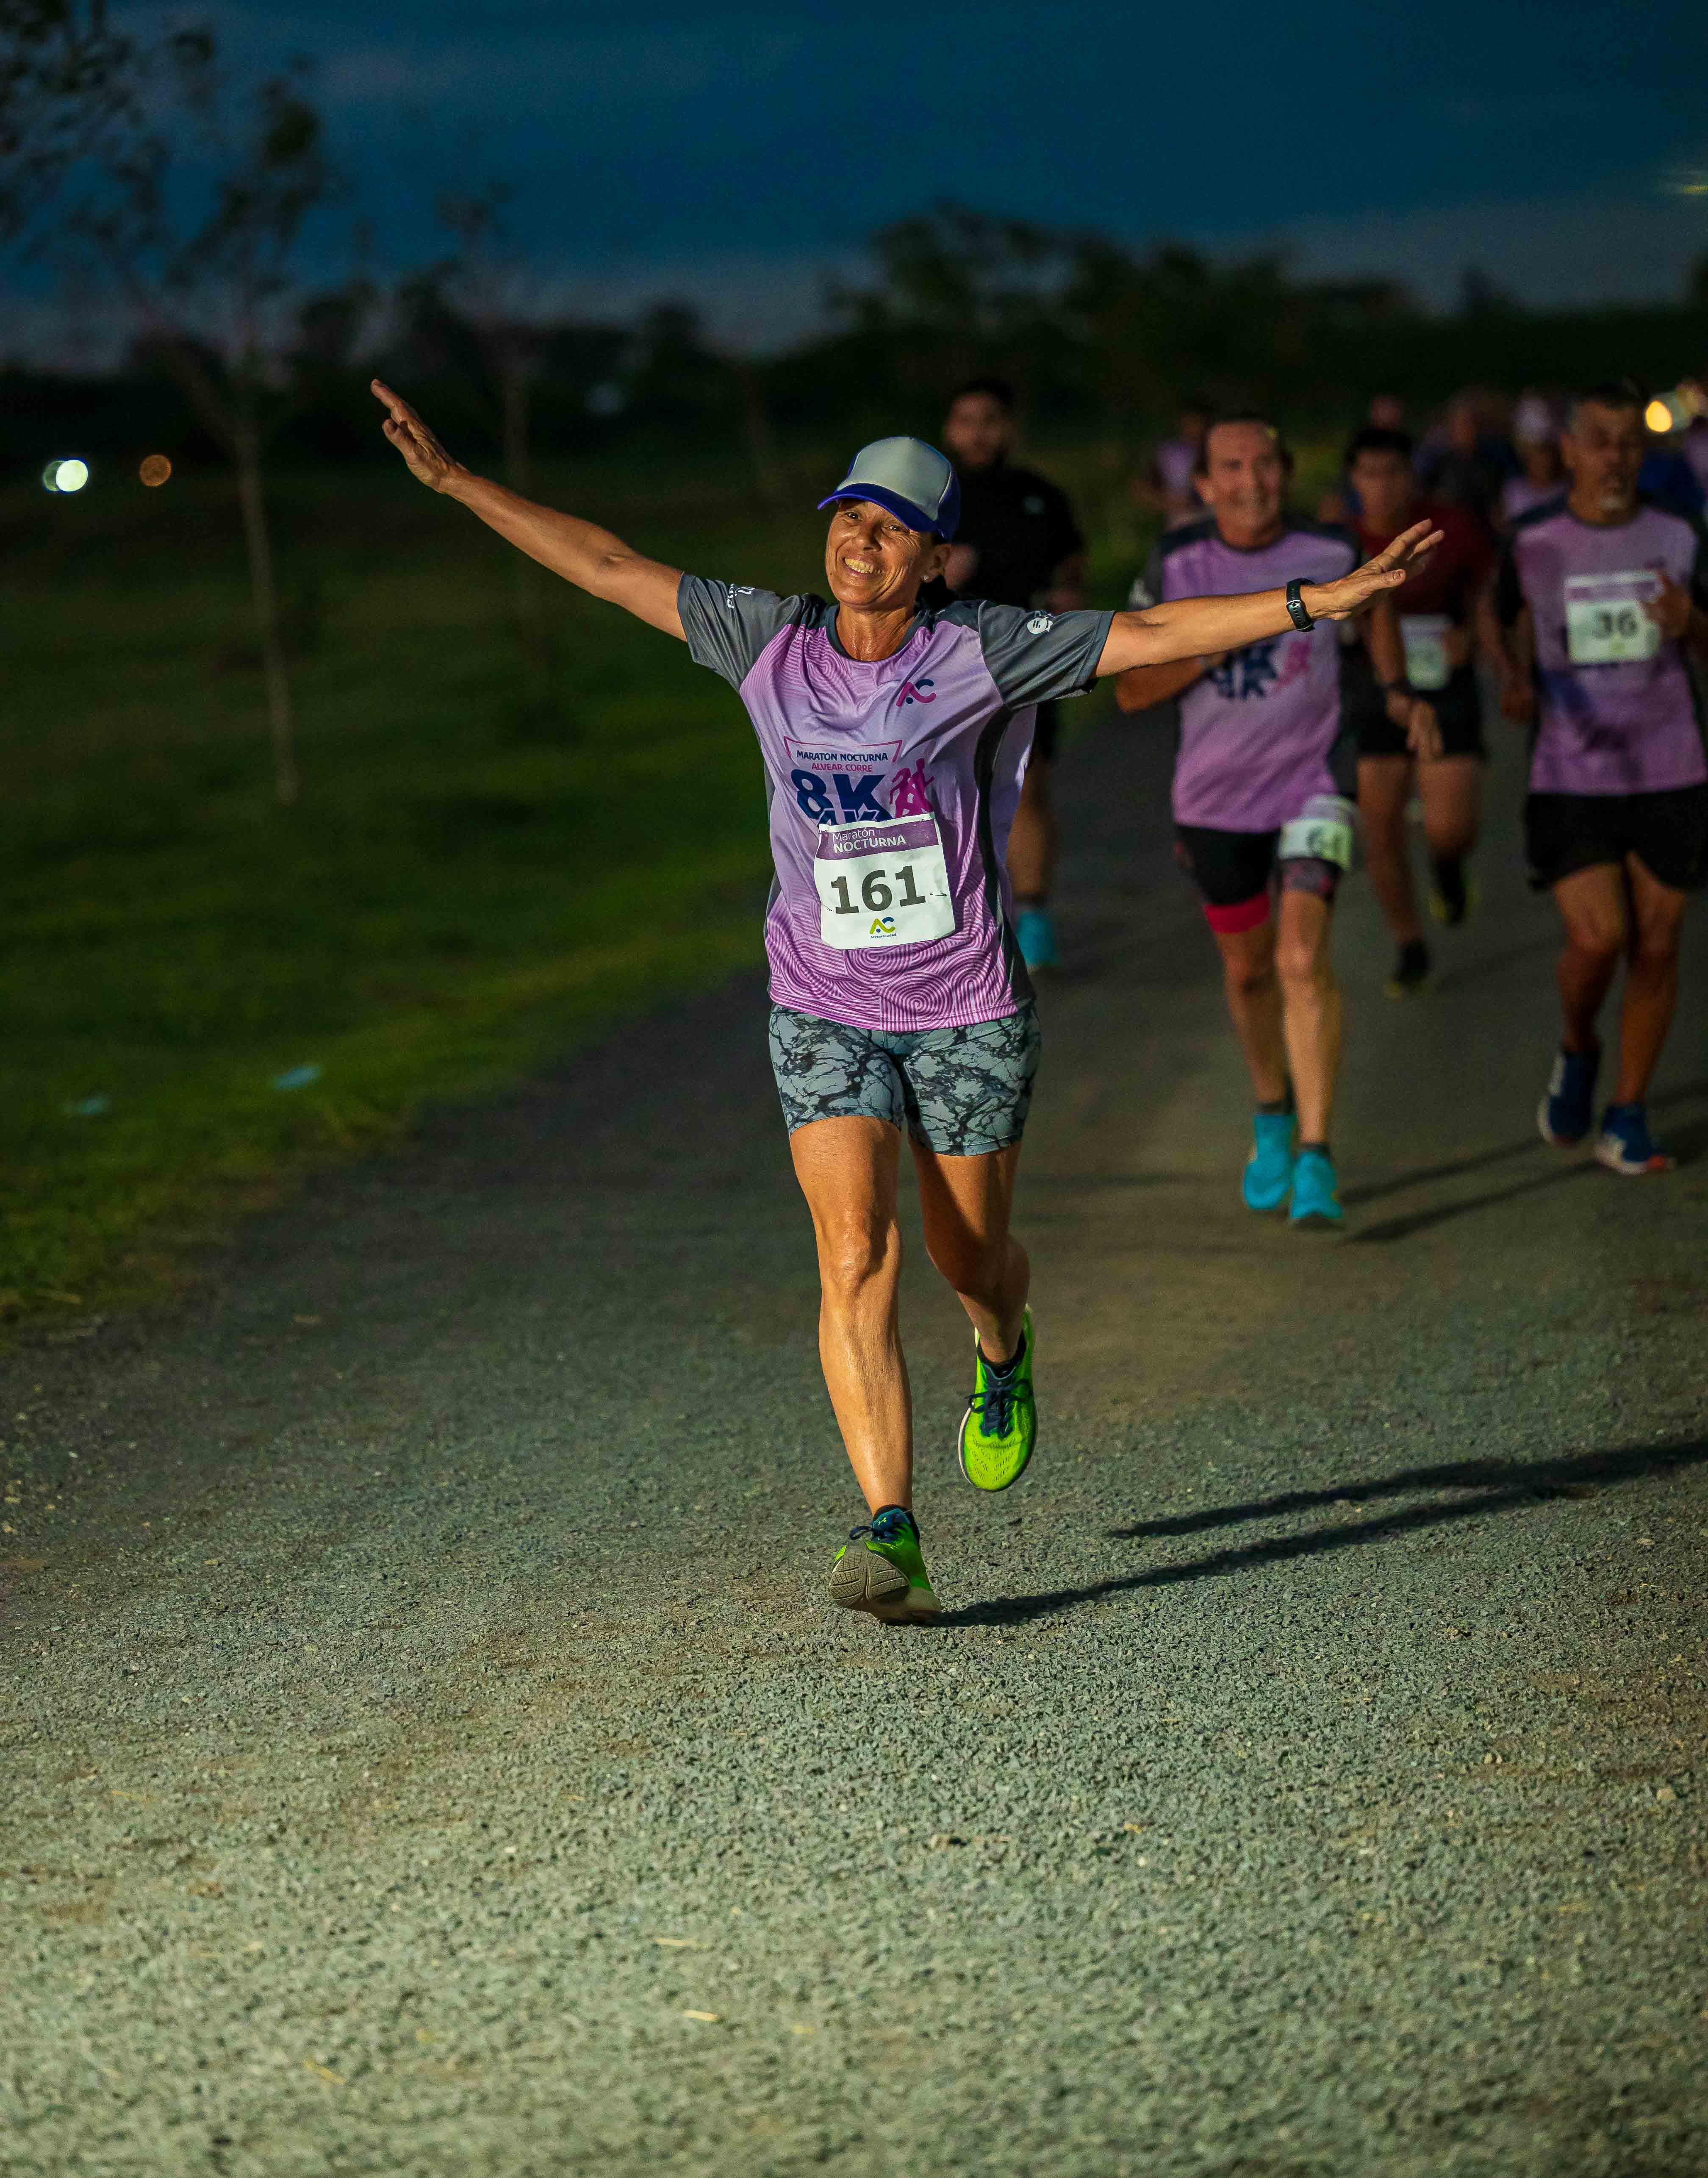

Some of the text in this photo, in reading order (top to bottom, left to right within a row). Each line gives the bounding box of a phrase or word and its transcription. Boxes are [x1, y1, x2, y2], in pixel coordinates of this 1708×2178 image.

[797, 750, 888, 762] MARATON NOCTURNA
[812, 763, 873, 772] ALVEAR CORRE
[790, 769, 893, 822] 8K
[833, 827, 875, 842] Maratón
[833, 835, 907, 853] NOCTURNA
[831, 866, 926, 914] 161
